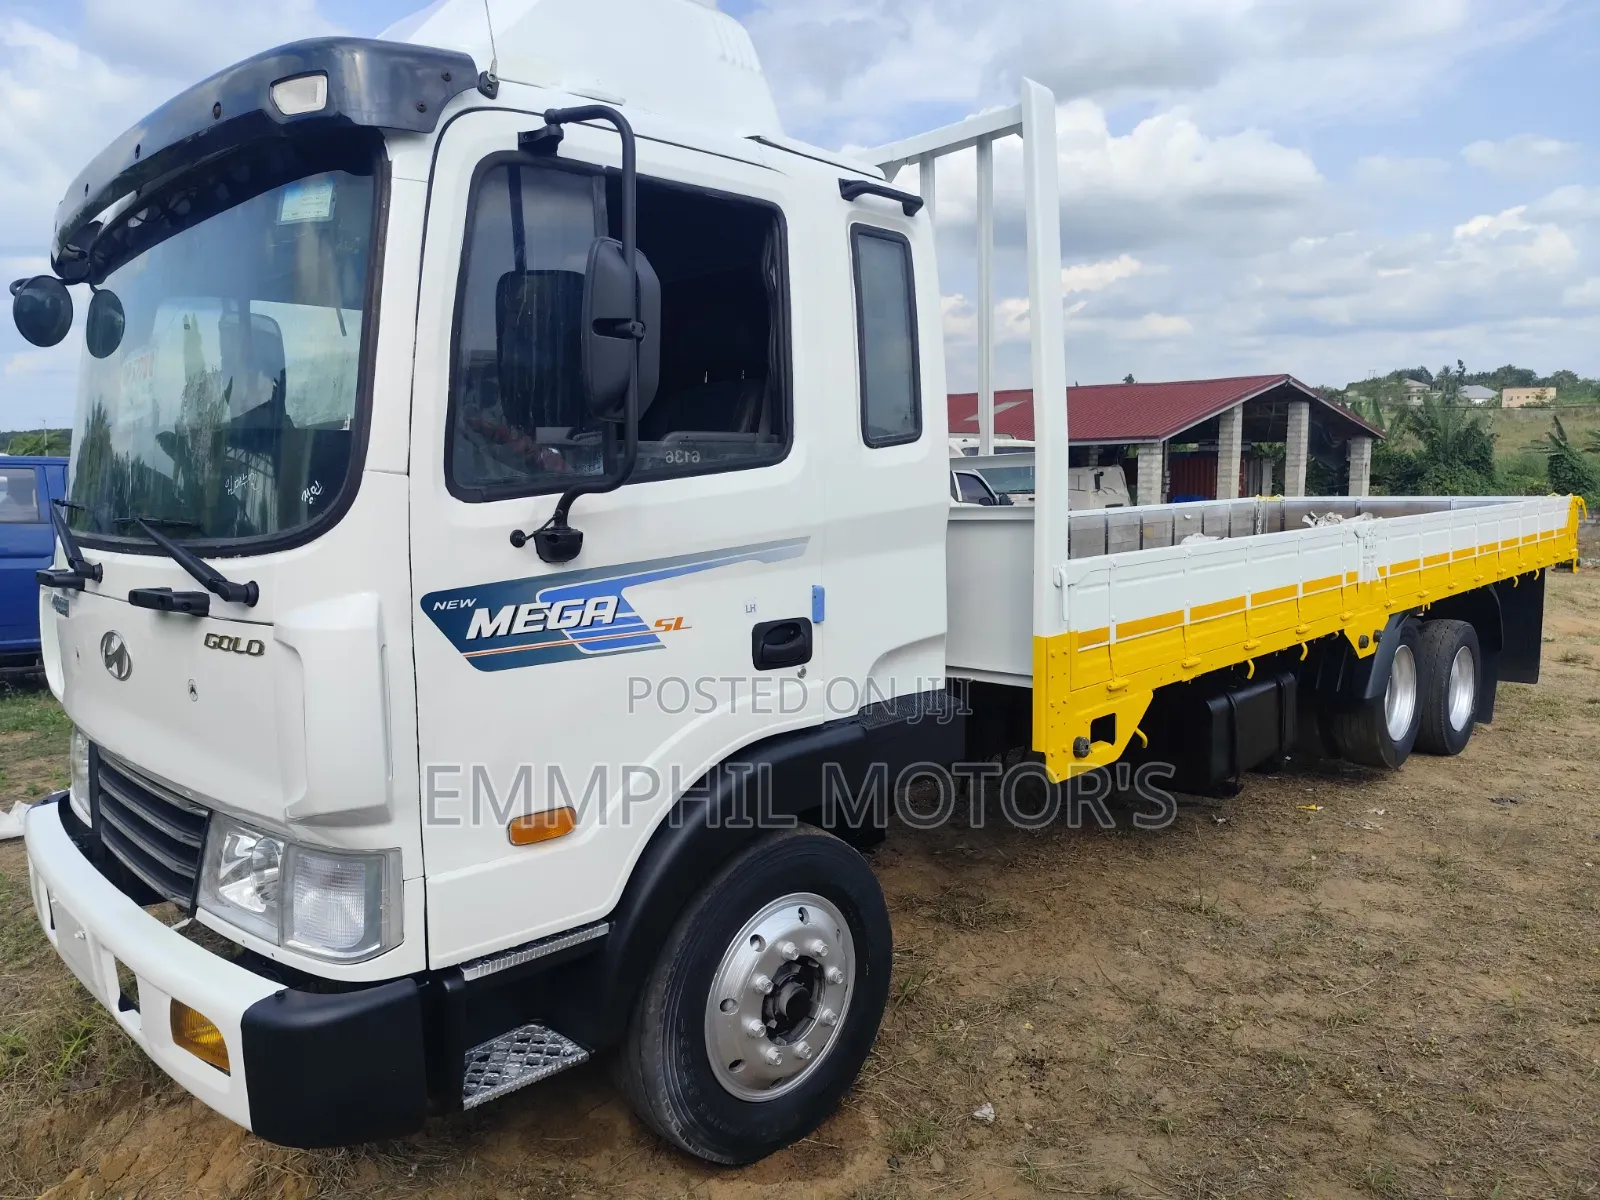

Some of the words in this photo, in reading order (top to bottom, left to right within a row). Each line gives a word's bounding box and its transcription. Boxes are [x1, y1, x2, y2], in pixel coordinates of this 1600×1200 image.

[433, 598, 477, 611] NEW
[465, 595, 620, 640] MEGA
[654, 616, 693, 633] SL
[204, 633, 266, 657] GOLD
